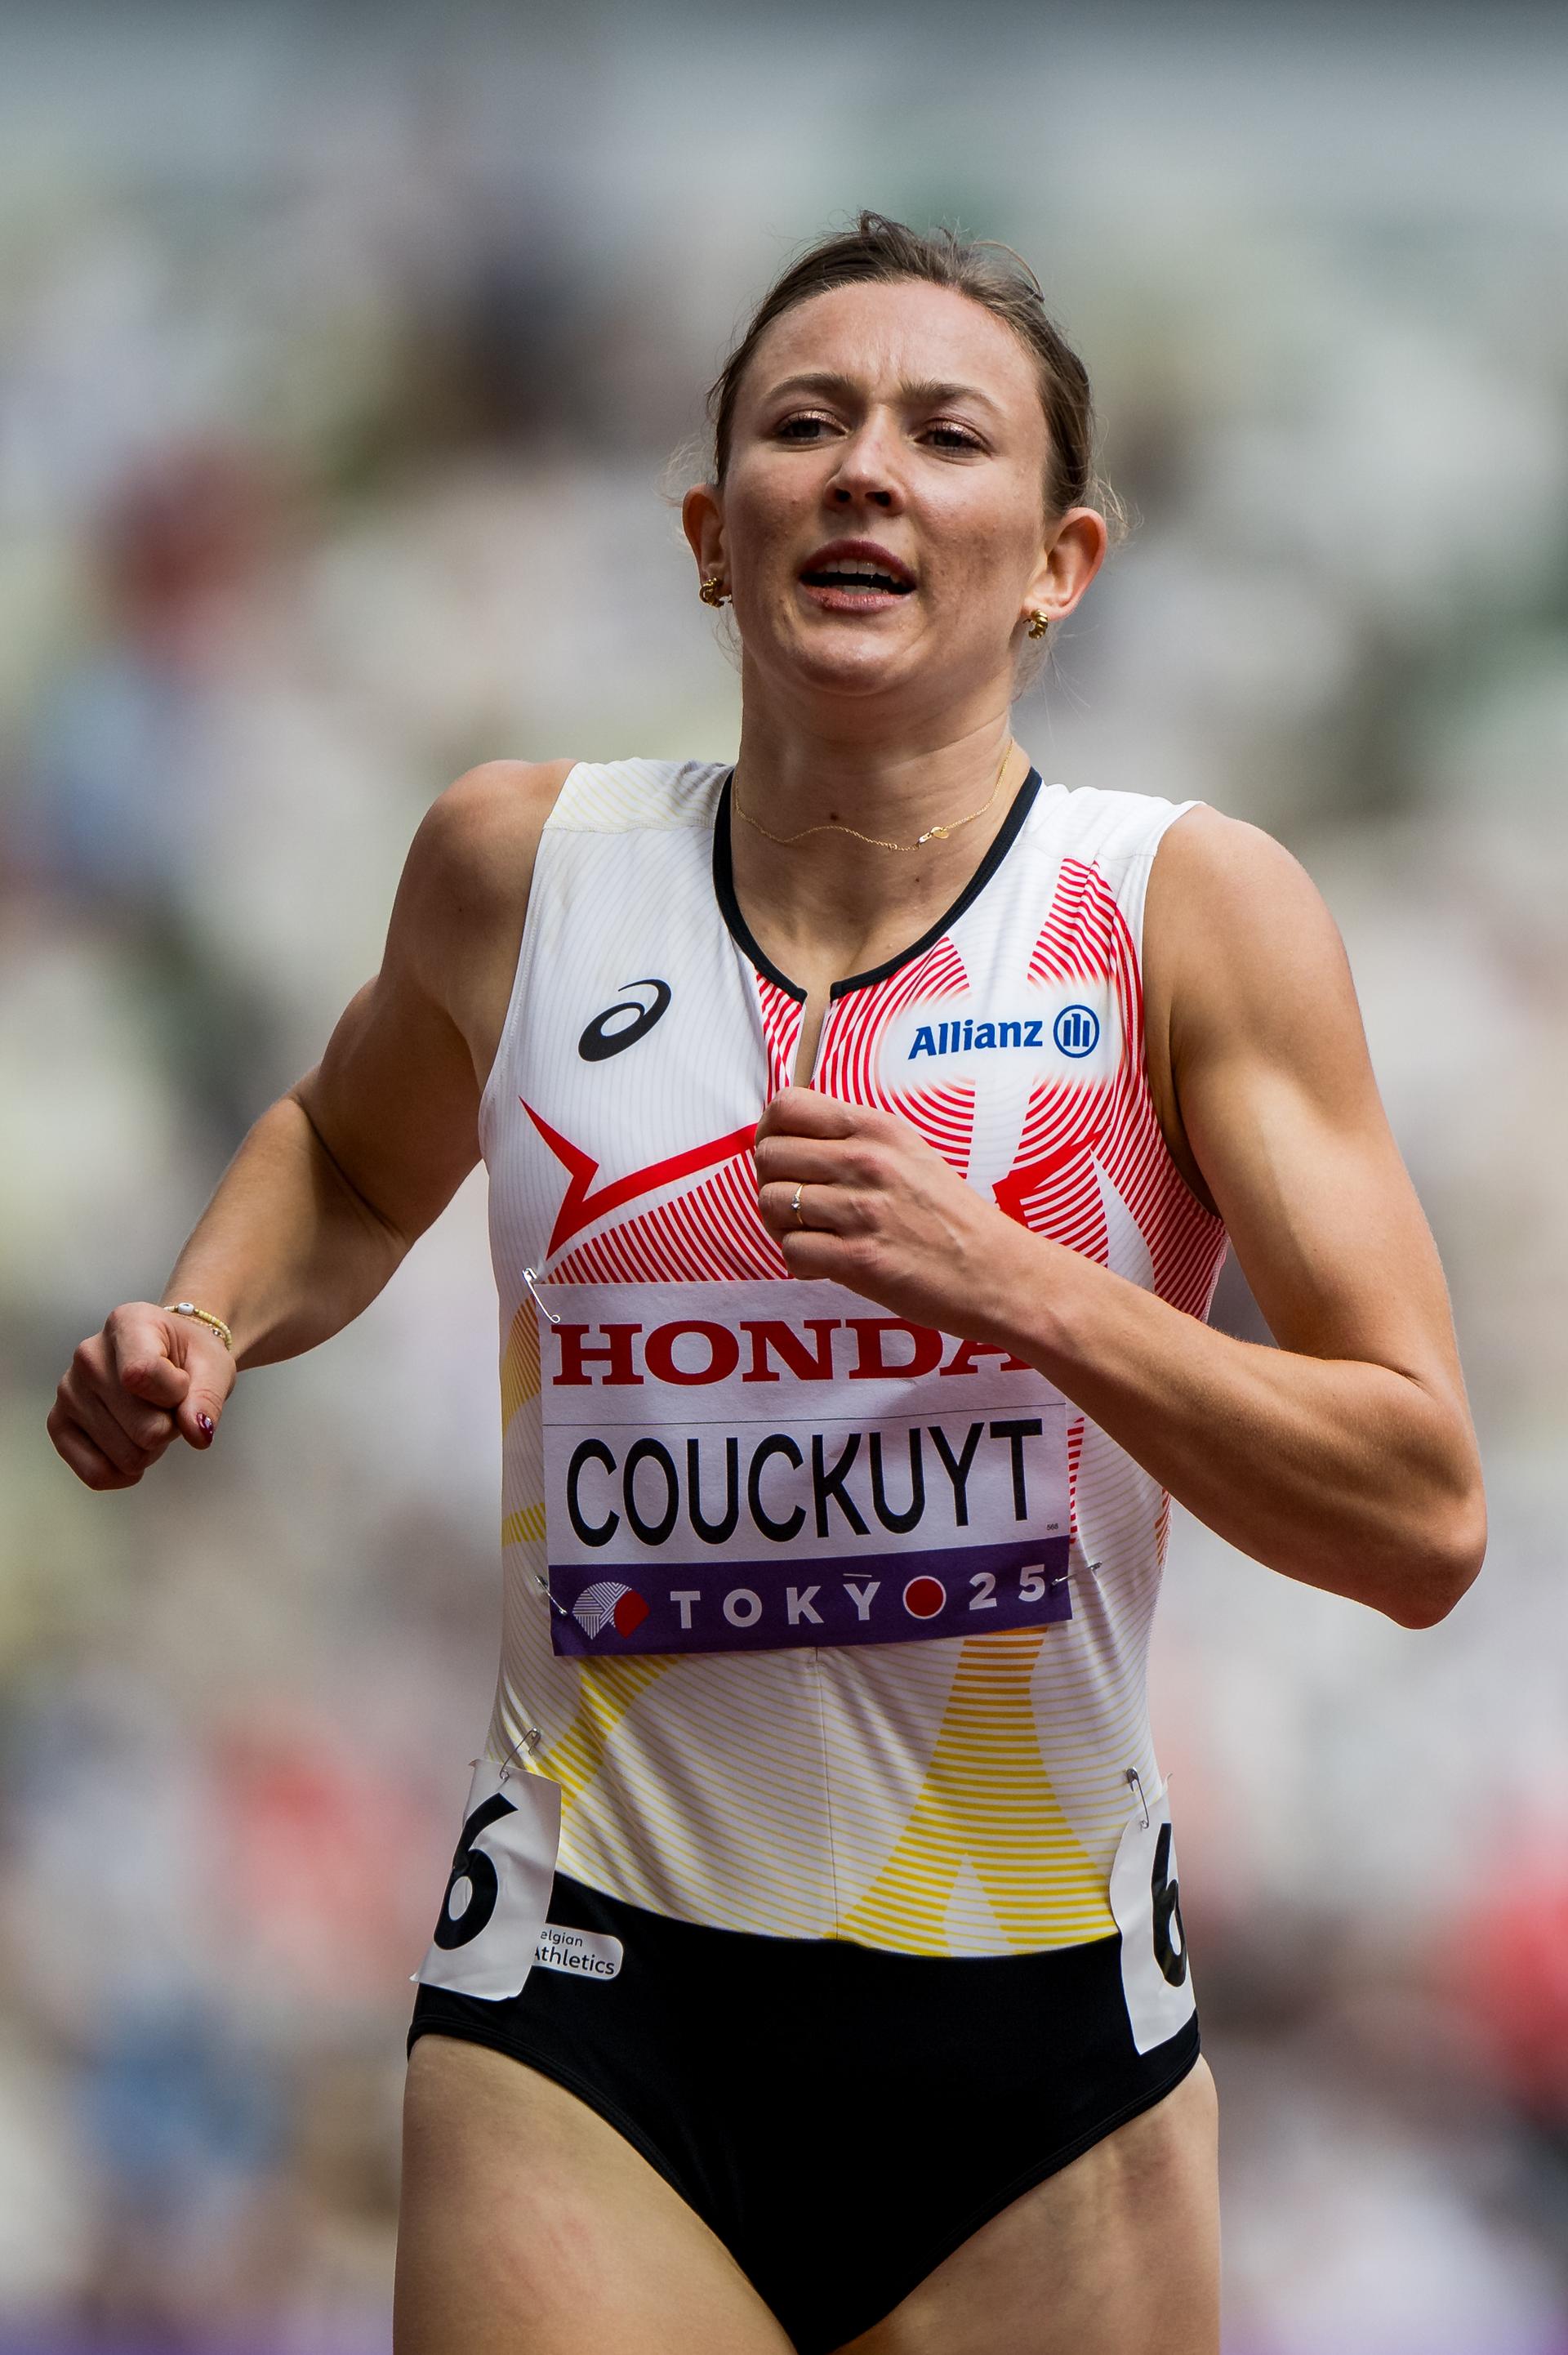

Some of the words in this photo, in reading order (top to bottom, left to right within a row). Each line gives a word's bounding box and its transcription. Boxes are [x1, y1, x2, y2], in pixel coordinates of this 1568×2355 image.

[907, 1019, 1044, 1060] Allianz
[550, 1317, 1036, 1385] HONDA
[566, 1417, 1043, 1547] COUCKUYT
[433, 1791, 519, 1951] 6
[1151, 1822, 1187, 1988] 6
[540, 1929, 584, 1947] elgian
